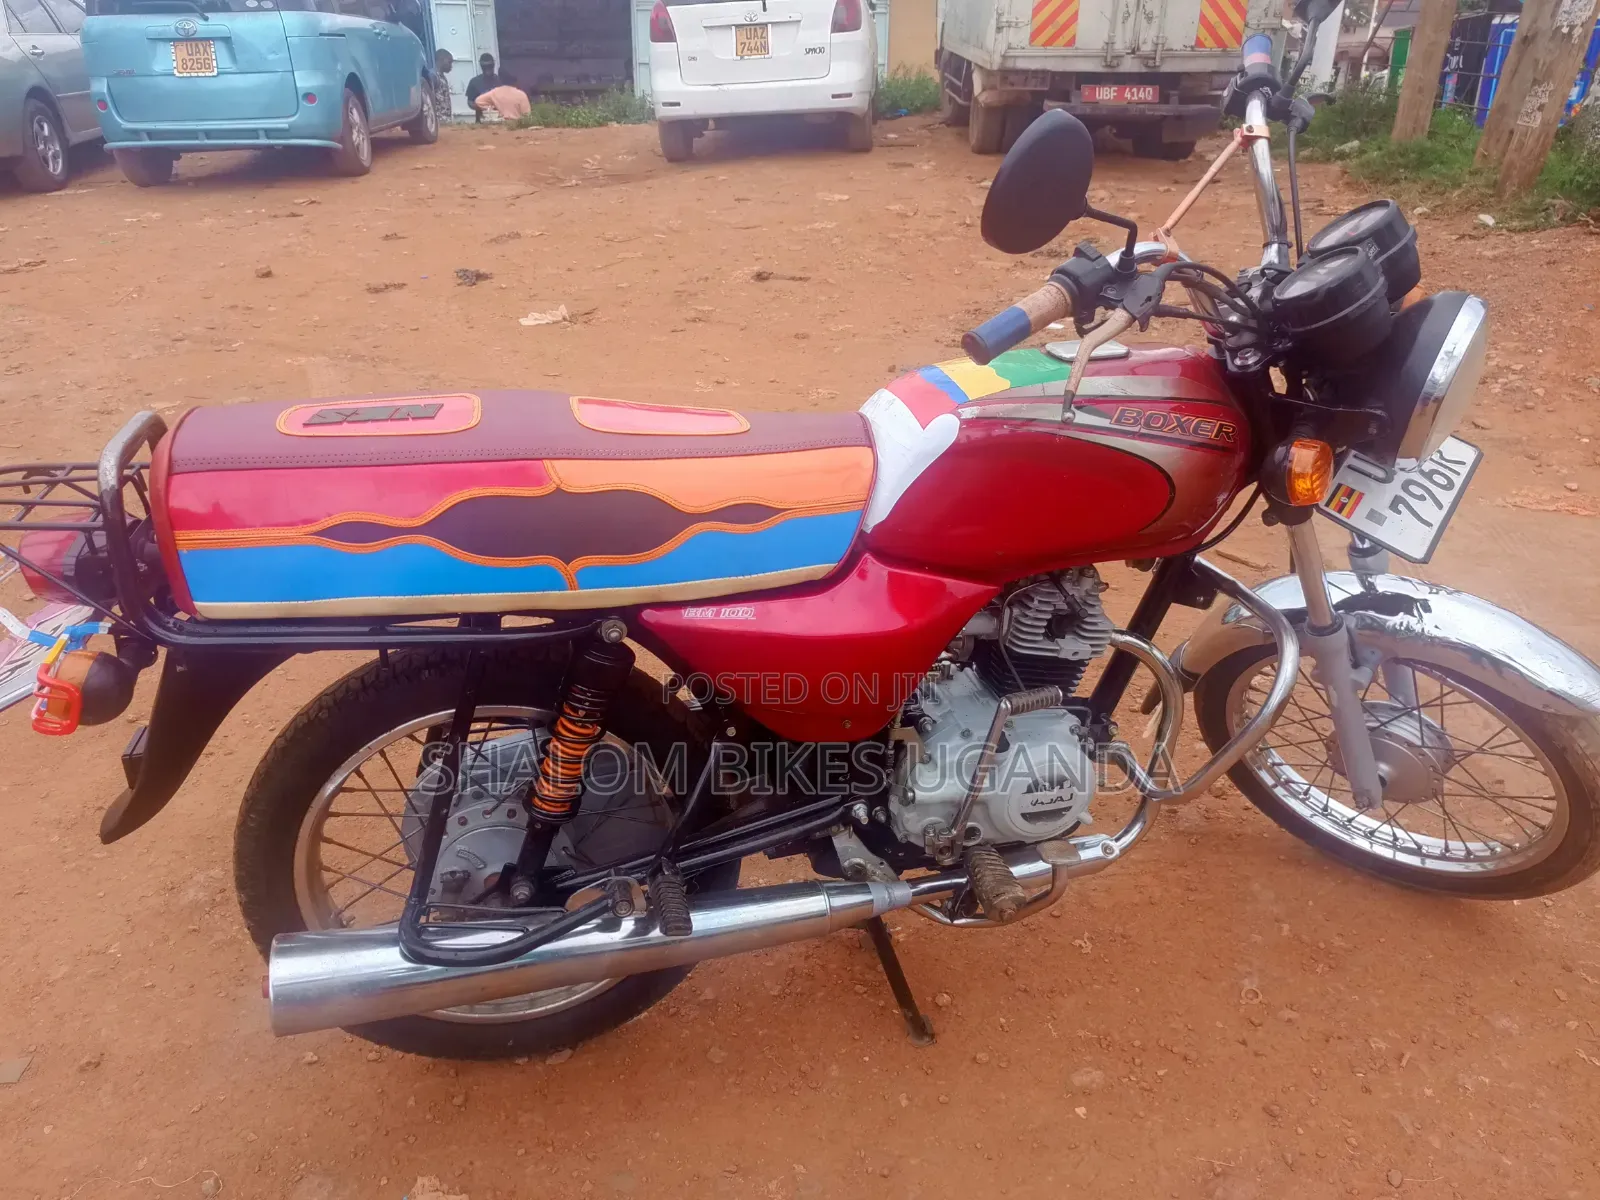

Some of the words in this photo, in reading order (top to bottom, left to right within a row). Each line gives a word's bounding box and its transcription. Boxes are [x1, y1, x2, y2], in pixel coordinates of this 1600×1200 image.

[745, 27, 767, 40] UAZ
[185, 42, 210, 56] UAX
[740, 41, 767, 54] 744N
[181, 57, 211, 71] 825G
[1095, 86, 1118, 100] UBF
[1110, 406, 1239, 442] BOXER
